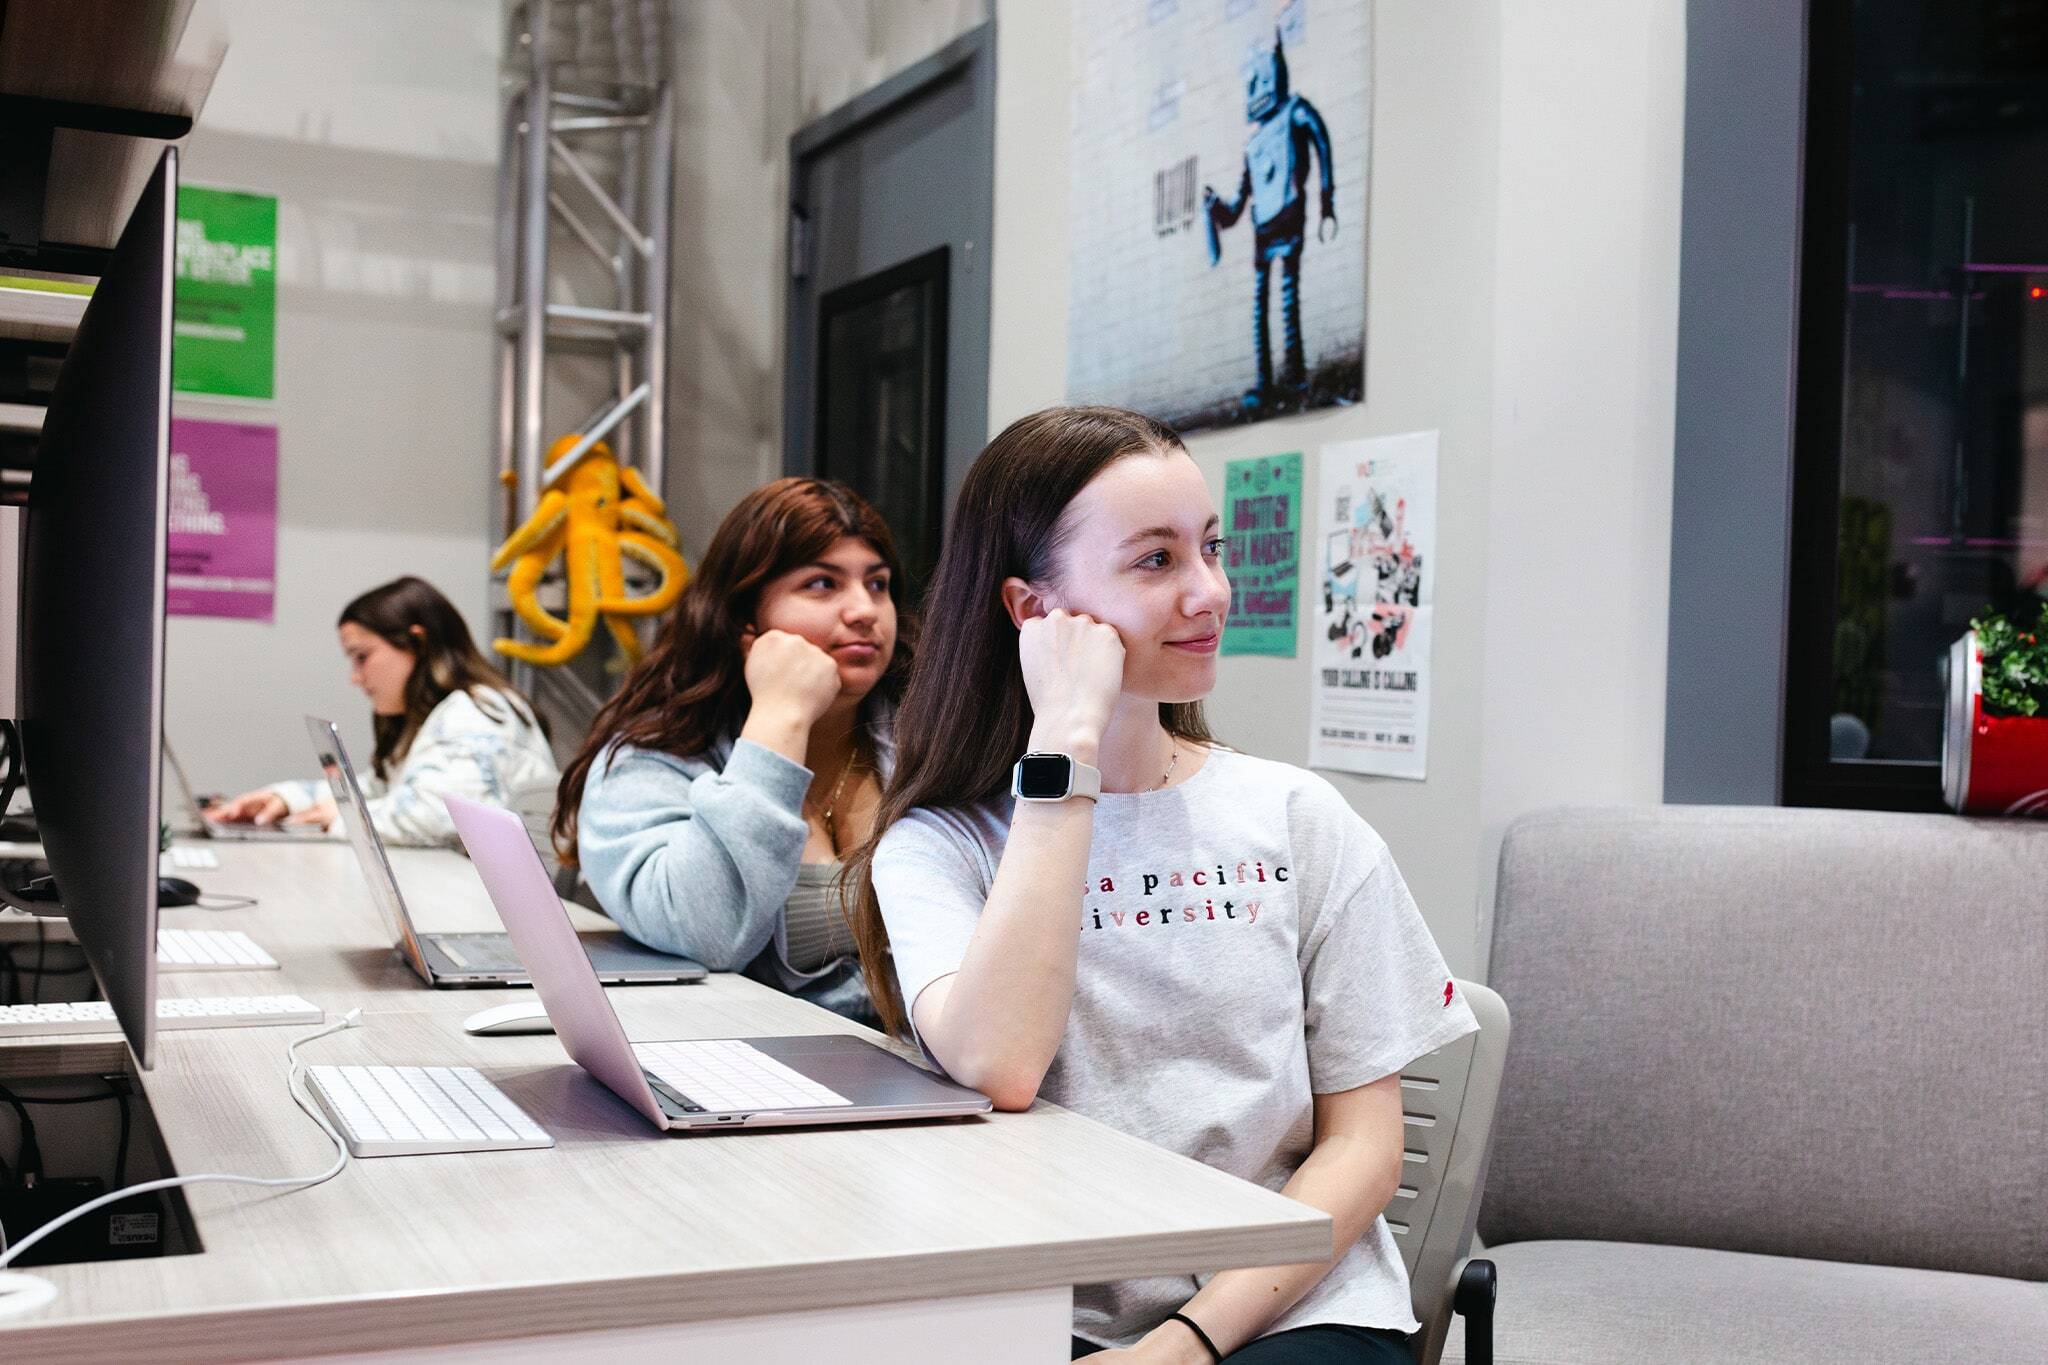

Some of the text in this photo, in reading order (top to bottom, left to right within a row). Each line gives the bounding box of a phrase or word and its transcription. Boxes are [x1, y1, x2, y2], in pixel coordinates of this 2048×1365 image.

[1341, 670, 1370, 689] CALLING
[1374, 671, 1380, 689] IS
[1384, 671, 1416, 691] CALLING
[1142, 862, 1289, 895] pacific
[1081, 899, 1261, 931] iversity
